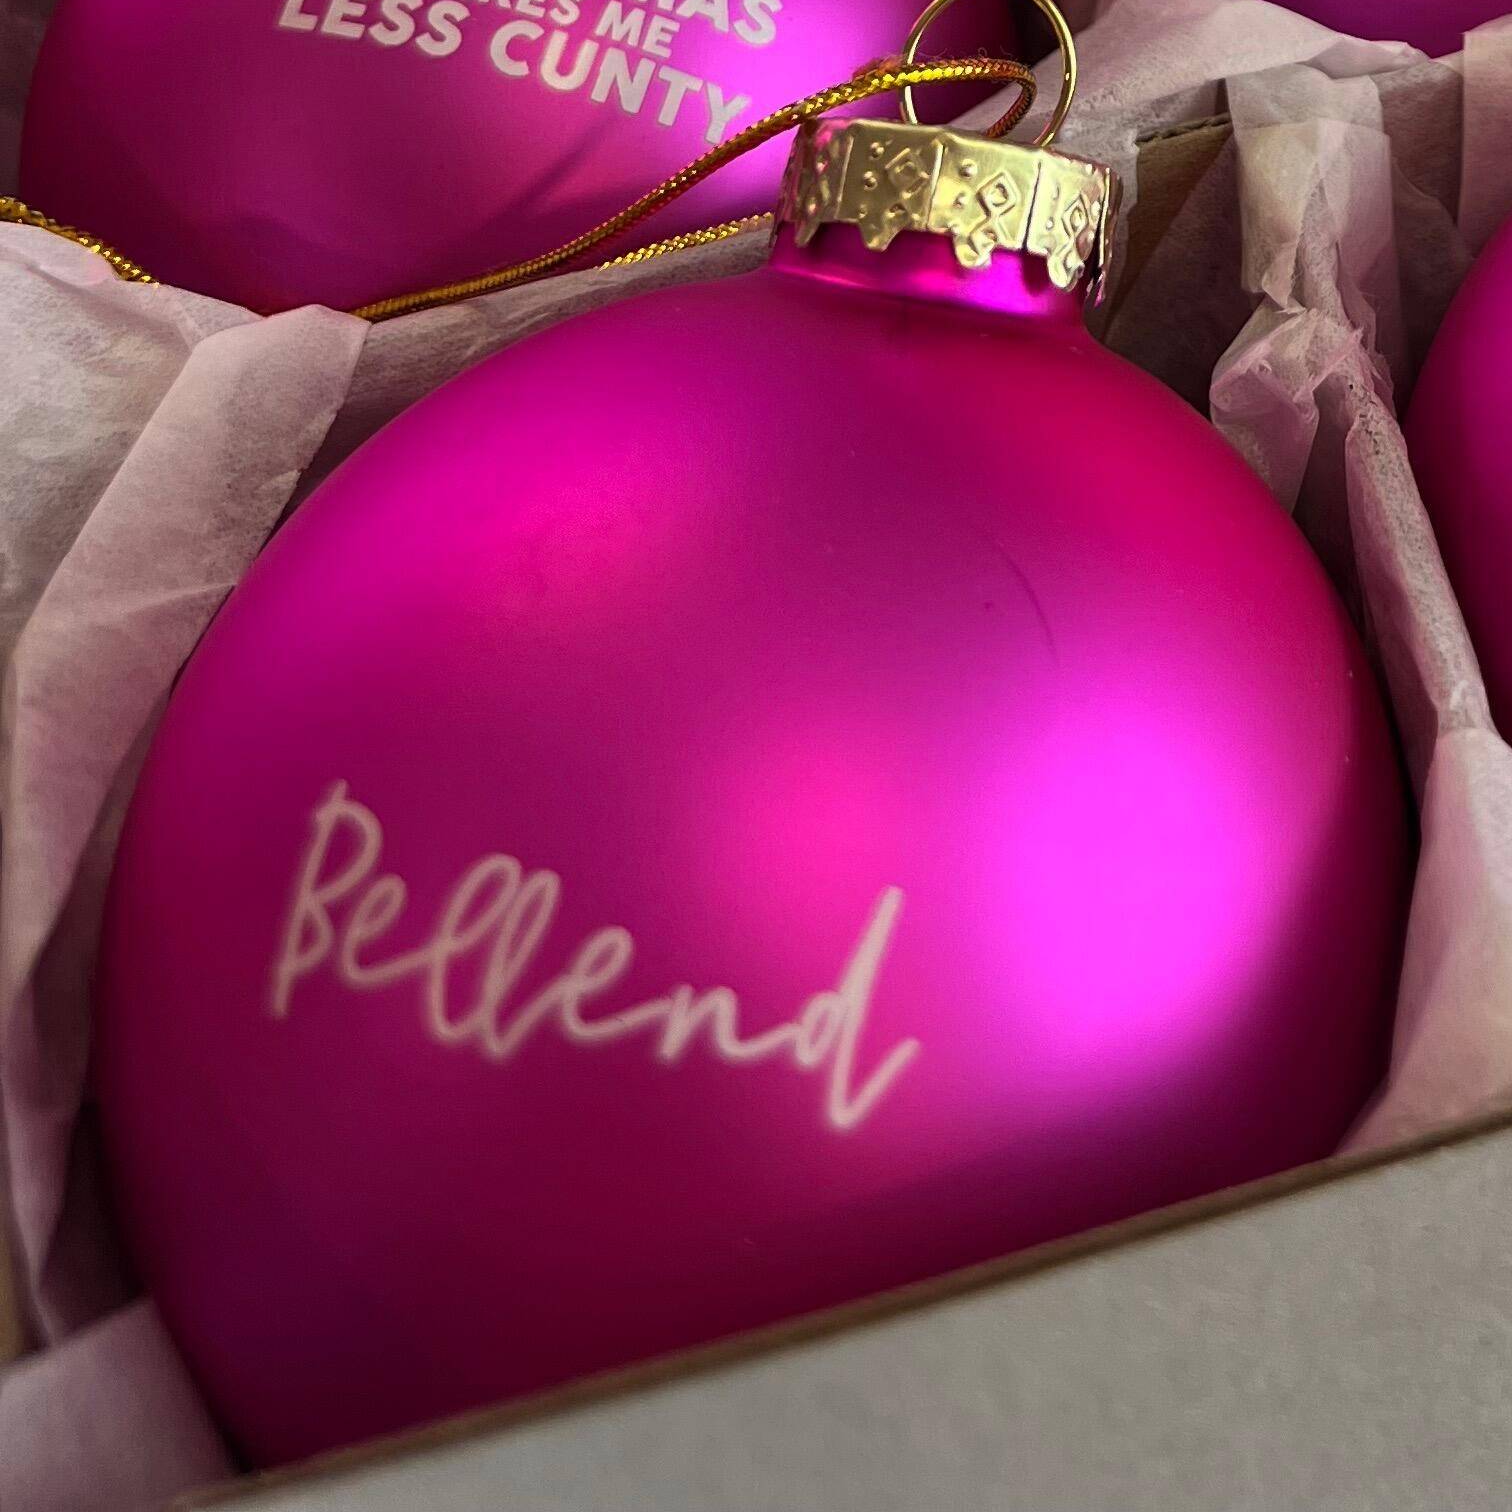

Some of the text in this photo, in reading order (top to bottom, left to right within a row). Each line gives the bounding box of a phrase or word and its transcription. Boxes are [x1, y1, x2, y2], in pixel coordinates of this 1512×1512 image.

[489, 20, 751, 145] CUNTY
[594, 0, 681, 59] ME
[271, 778, 920, 1130] Bellend
